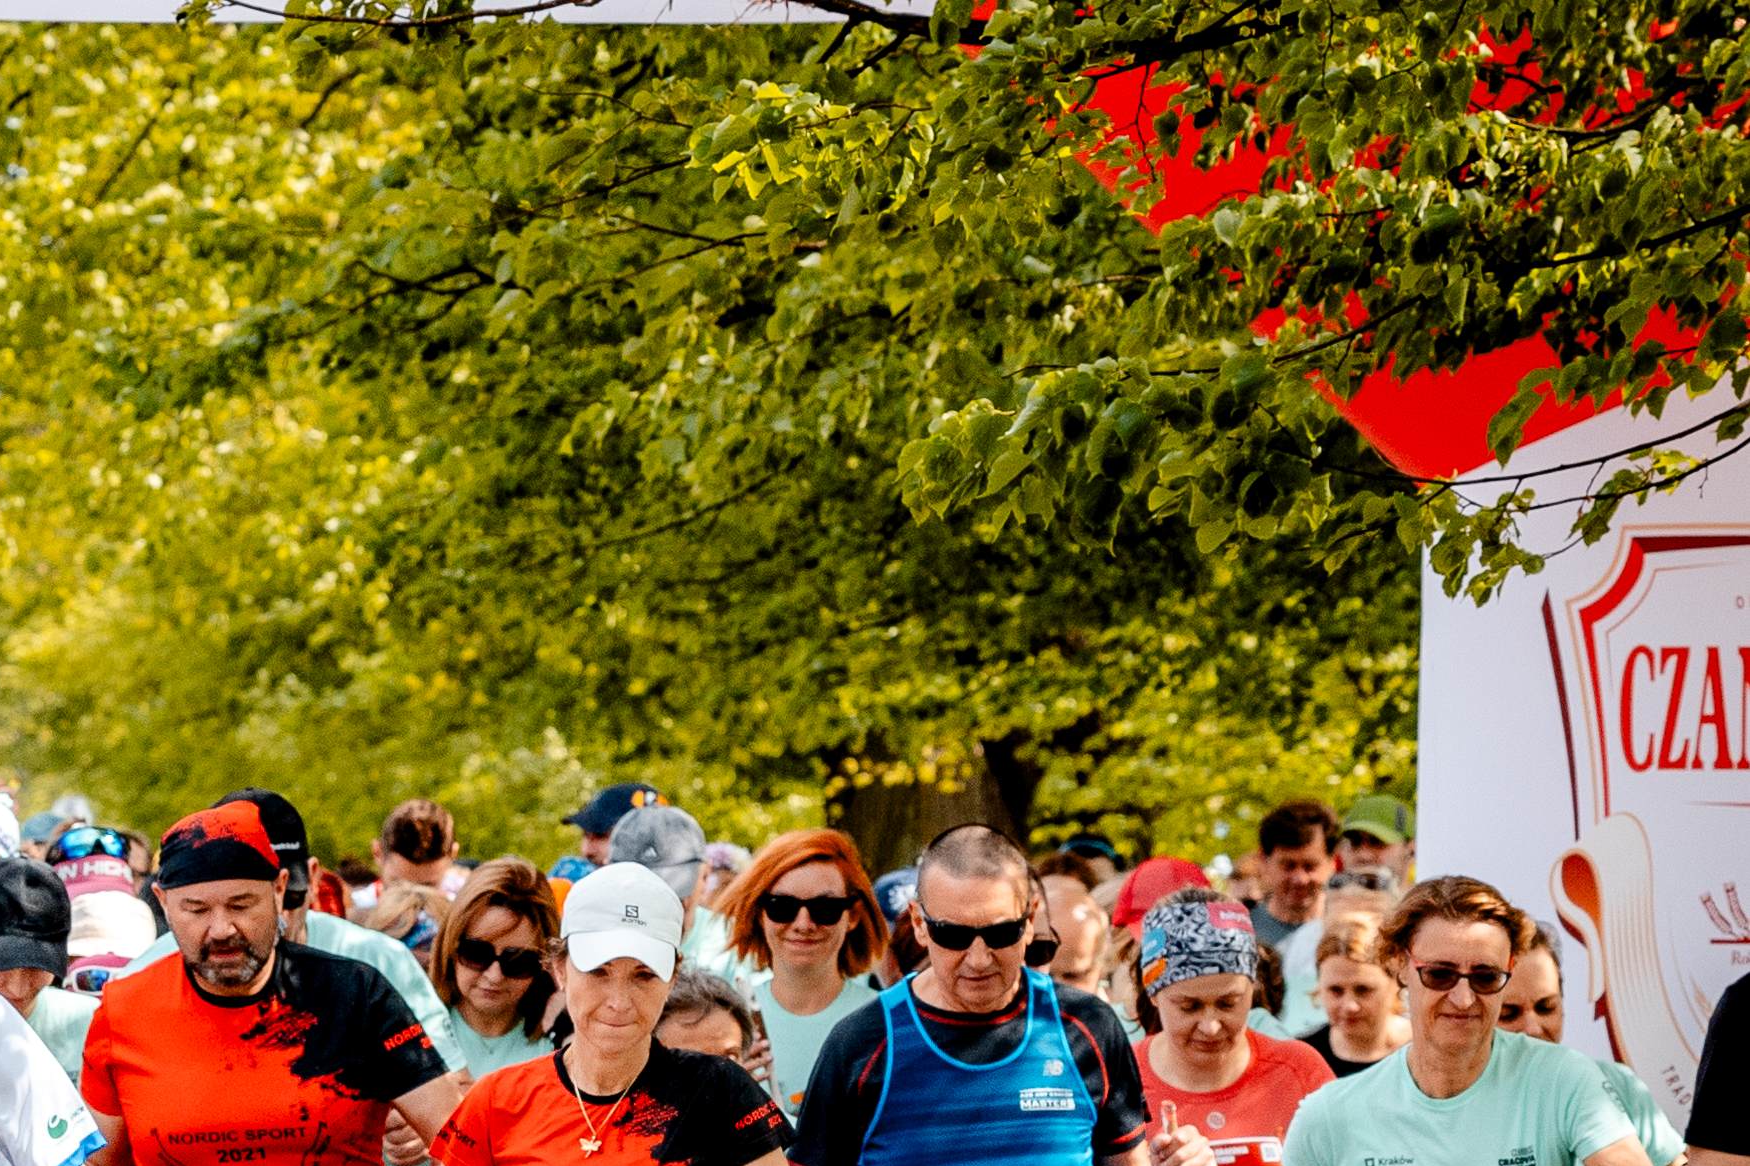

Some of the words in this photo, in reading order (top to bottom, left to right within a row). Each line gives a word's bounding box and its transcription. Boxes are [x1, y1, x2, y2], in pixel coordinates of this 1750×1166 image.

[1661, 1065, 1692, 1106] TRAD
[168, 1129, 238, 1145] NORDIC
[245, 1127, 307, 1141] SPORT
[216, 1147, 266, 1163] 2021
[1378, 1155, 1414, 1166] Kraków
